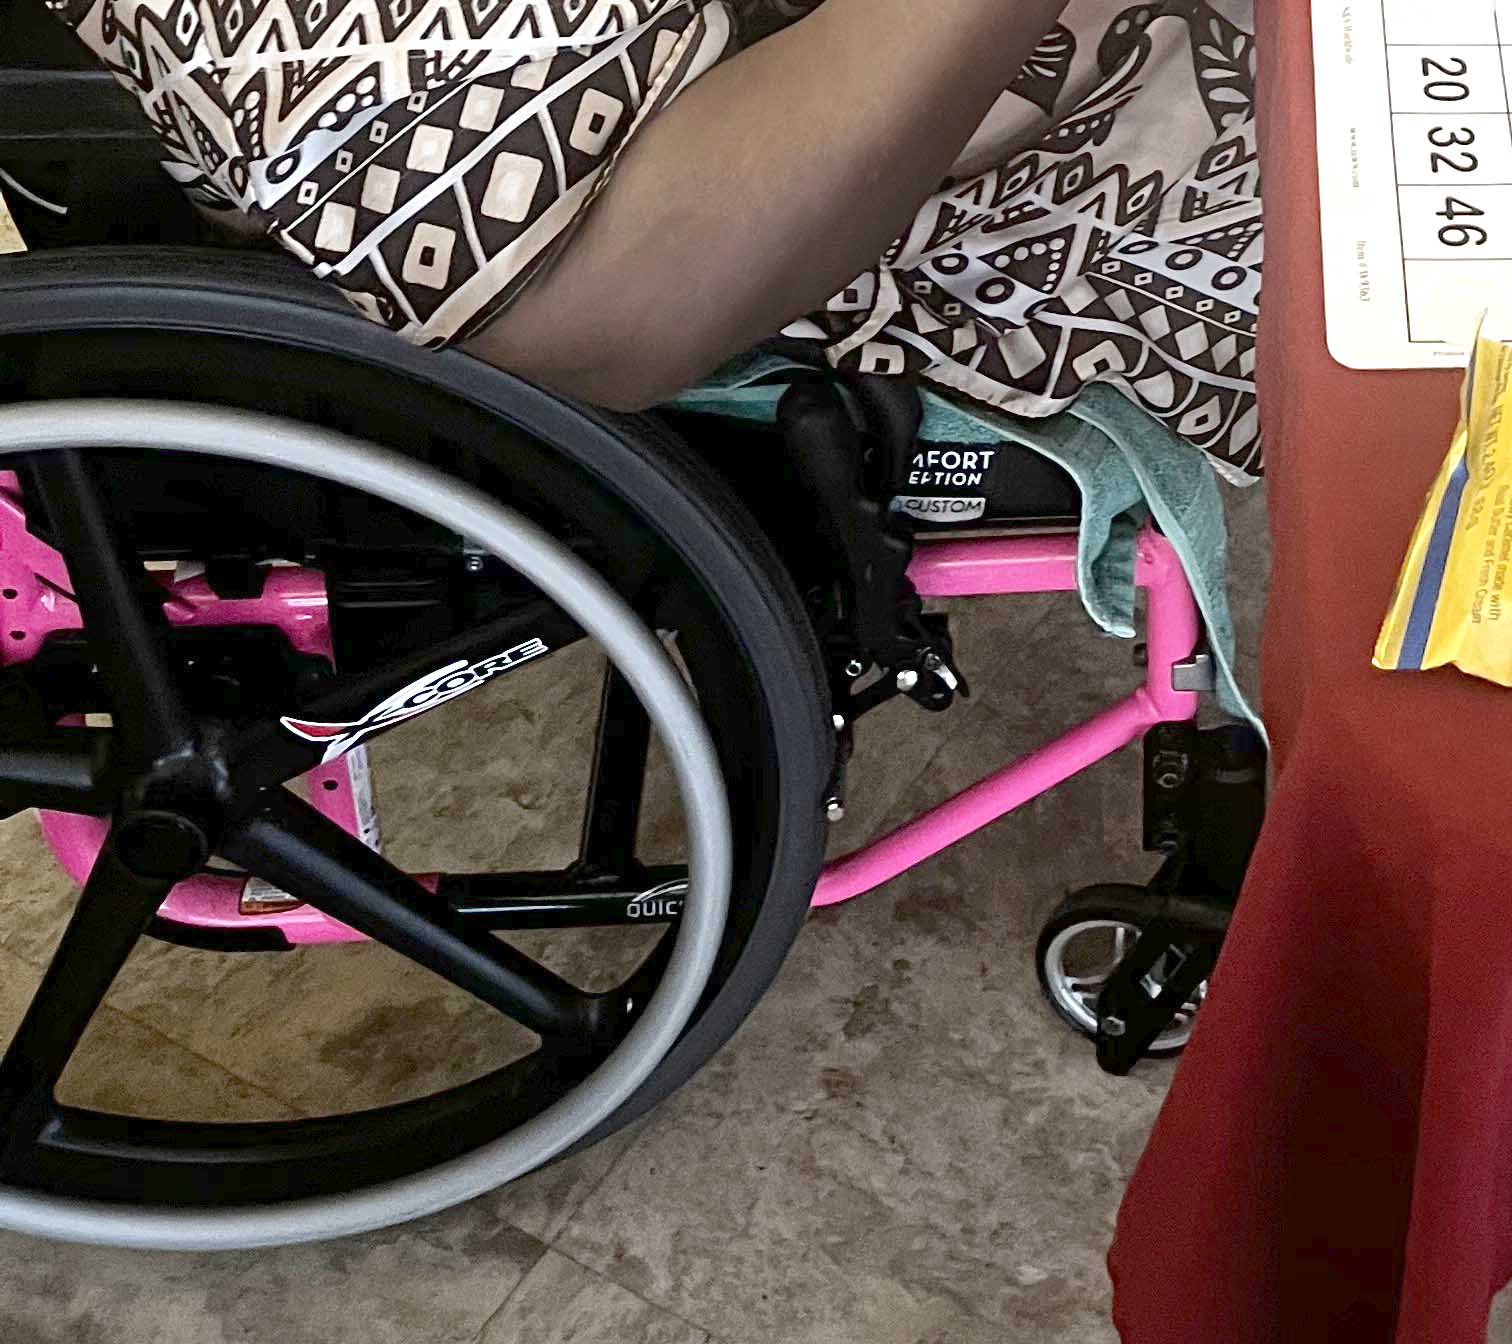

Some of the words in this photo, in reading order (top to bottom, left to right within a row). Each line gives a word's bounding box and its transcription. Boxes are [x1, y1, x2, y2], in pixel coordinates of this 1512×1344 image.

[1420, 56, 1471, 102] 20
[1426, 126, 1479, 174] 32
[1434, 196, 1488, 248] 46
[1487, 593, 1503, 621] with
[626, 900, 683, 918] QUIC
